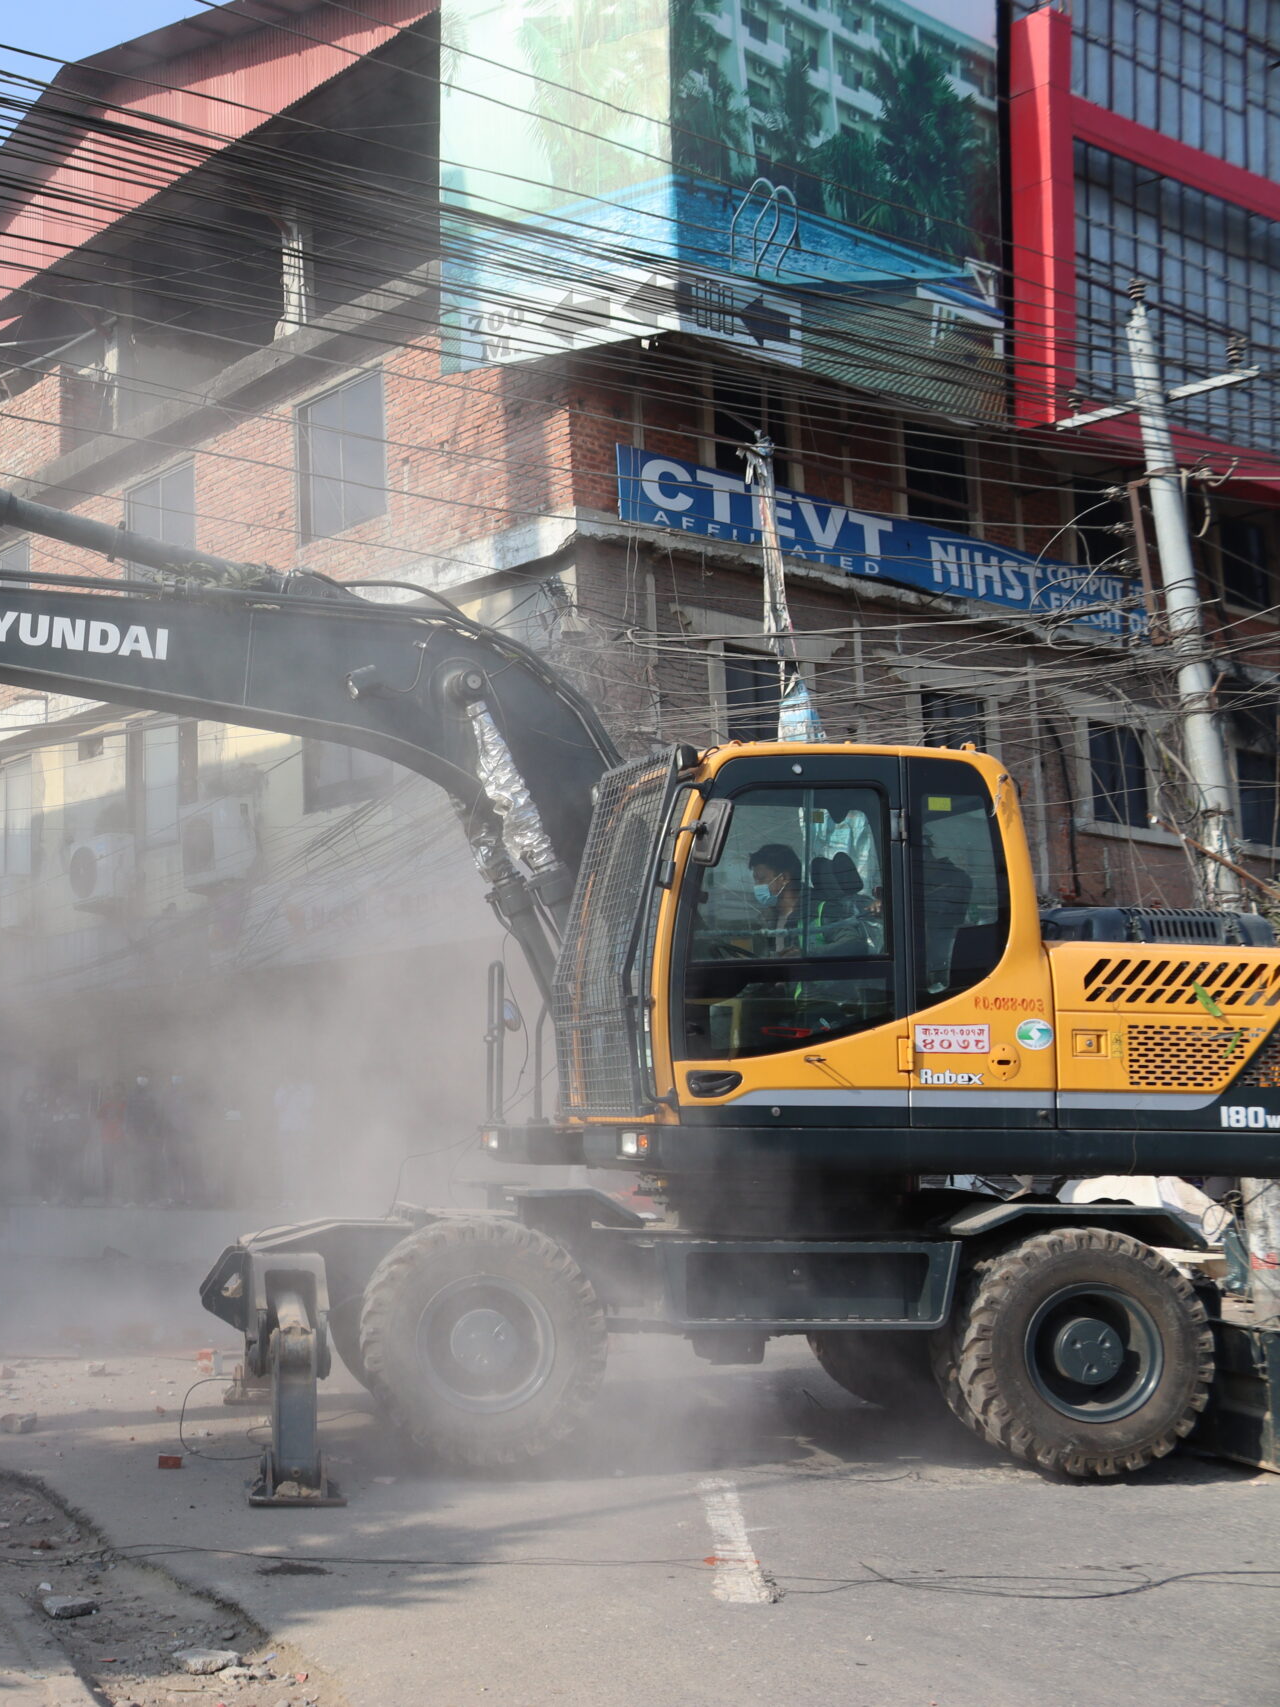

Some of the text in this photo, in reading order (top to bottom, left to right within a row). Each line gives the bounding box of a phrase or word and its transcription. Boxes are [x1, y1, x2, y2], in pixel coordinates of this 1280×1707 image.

[641, 458, 893, 560] CTEVT
[930, 541, 1043, 605] NIHST
[920, 1068, 984, 1085] Robex
